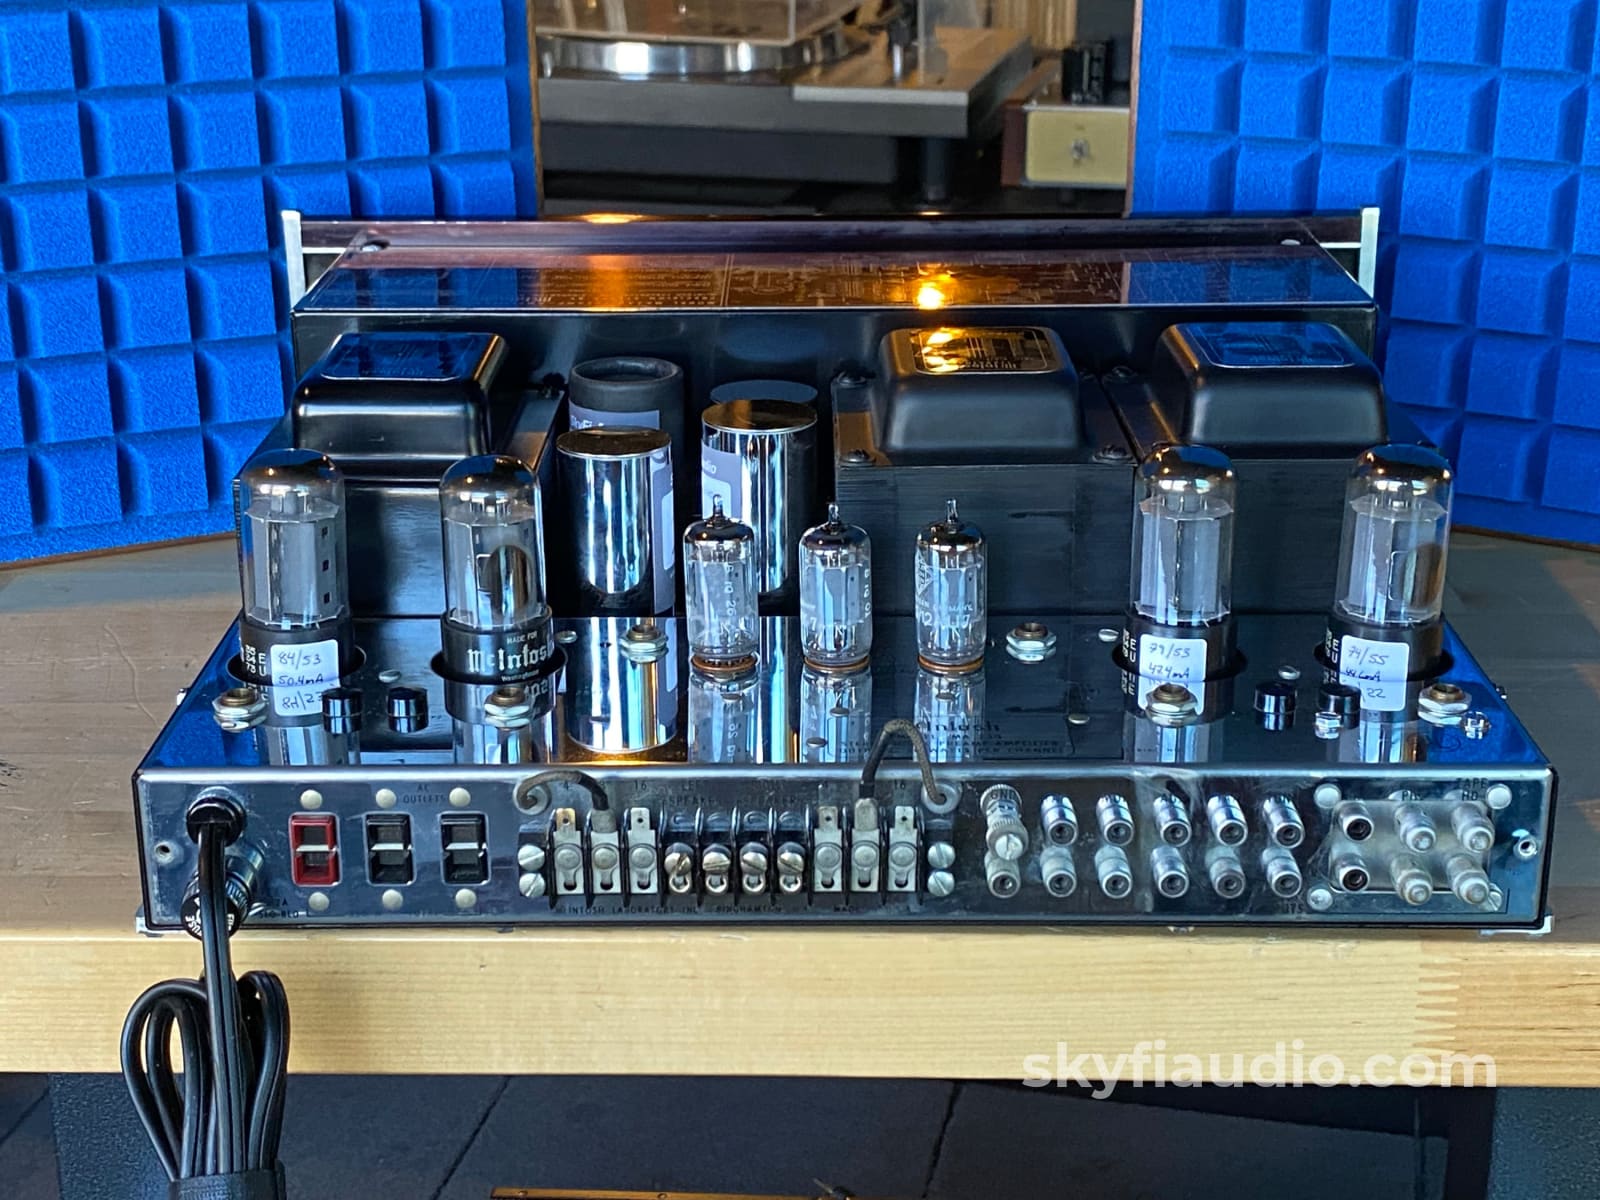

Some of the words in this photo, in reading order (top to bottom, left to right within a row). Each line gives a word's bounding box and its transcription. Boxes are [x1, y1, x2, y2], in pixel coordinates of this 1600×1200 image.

[278, 650, 322, 671] 84/53
[467, 643, 548, 673] McIntos
[417, 783, 430, 793] AC
[634, 780, 647, 791] 16
[1455, 777, 1487, 789] TAPE
[403, 794, 447, 804] OUTLETS
